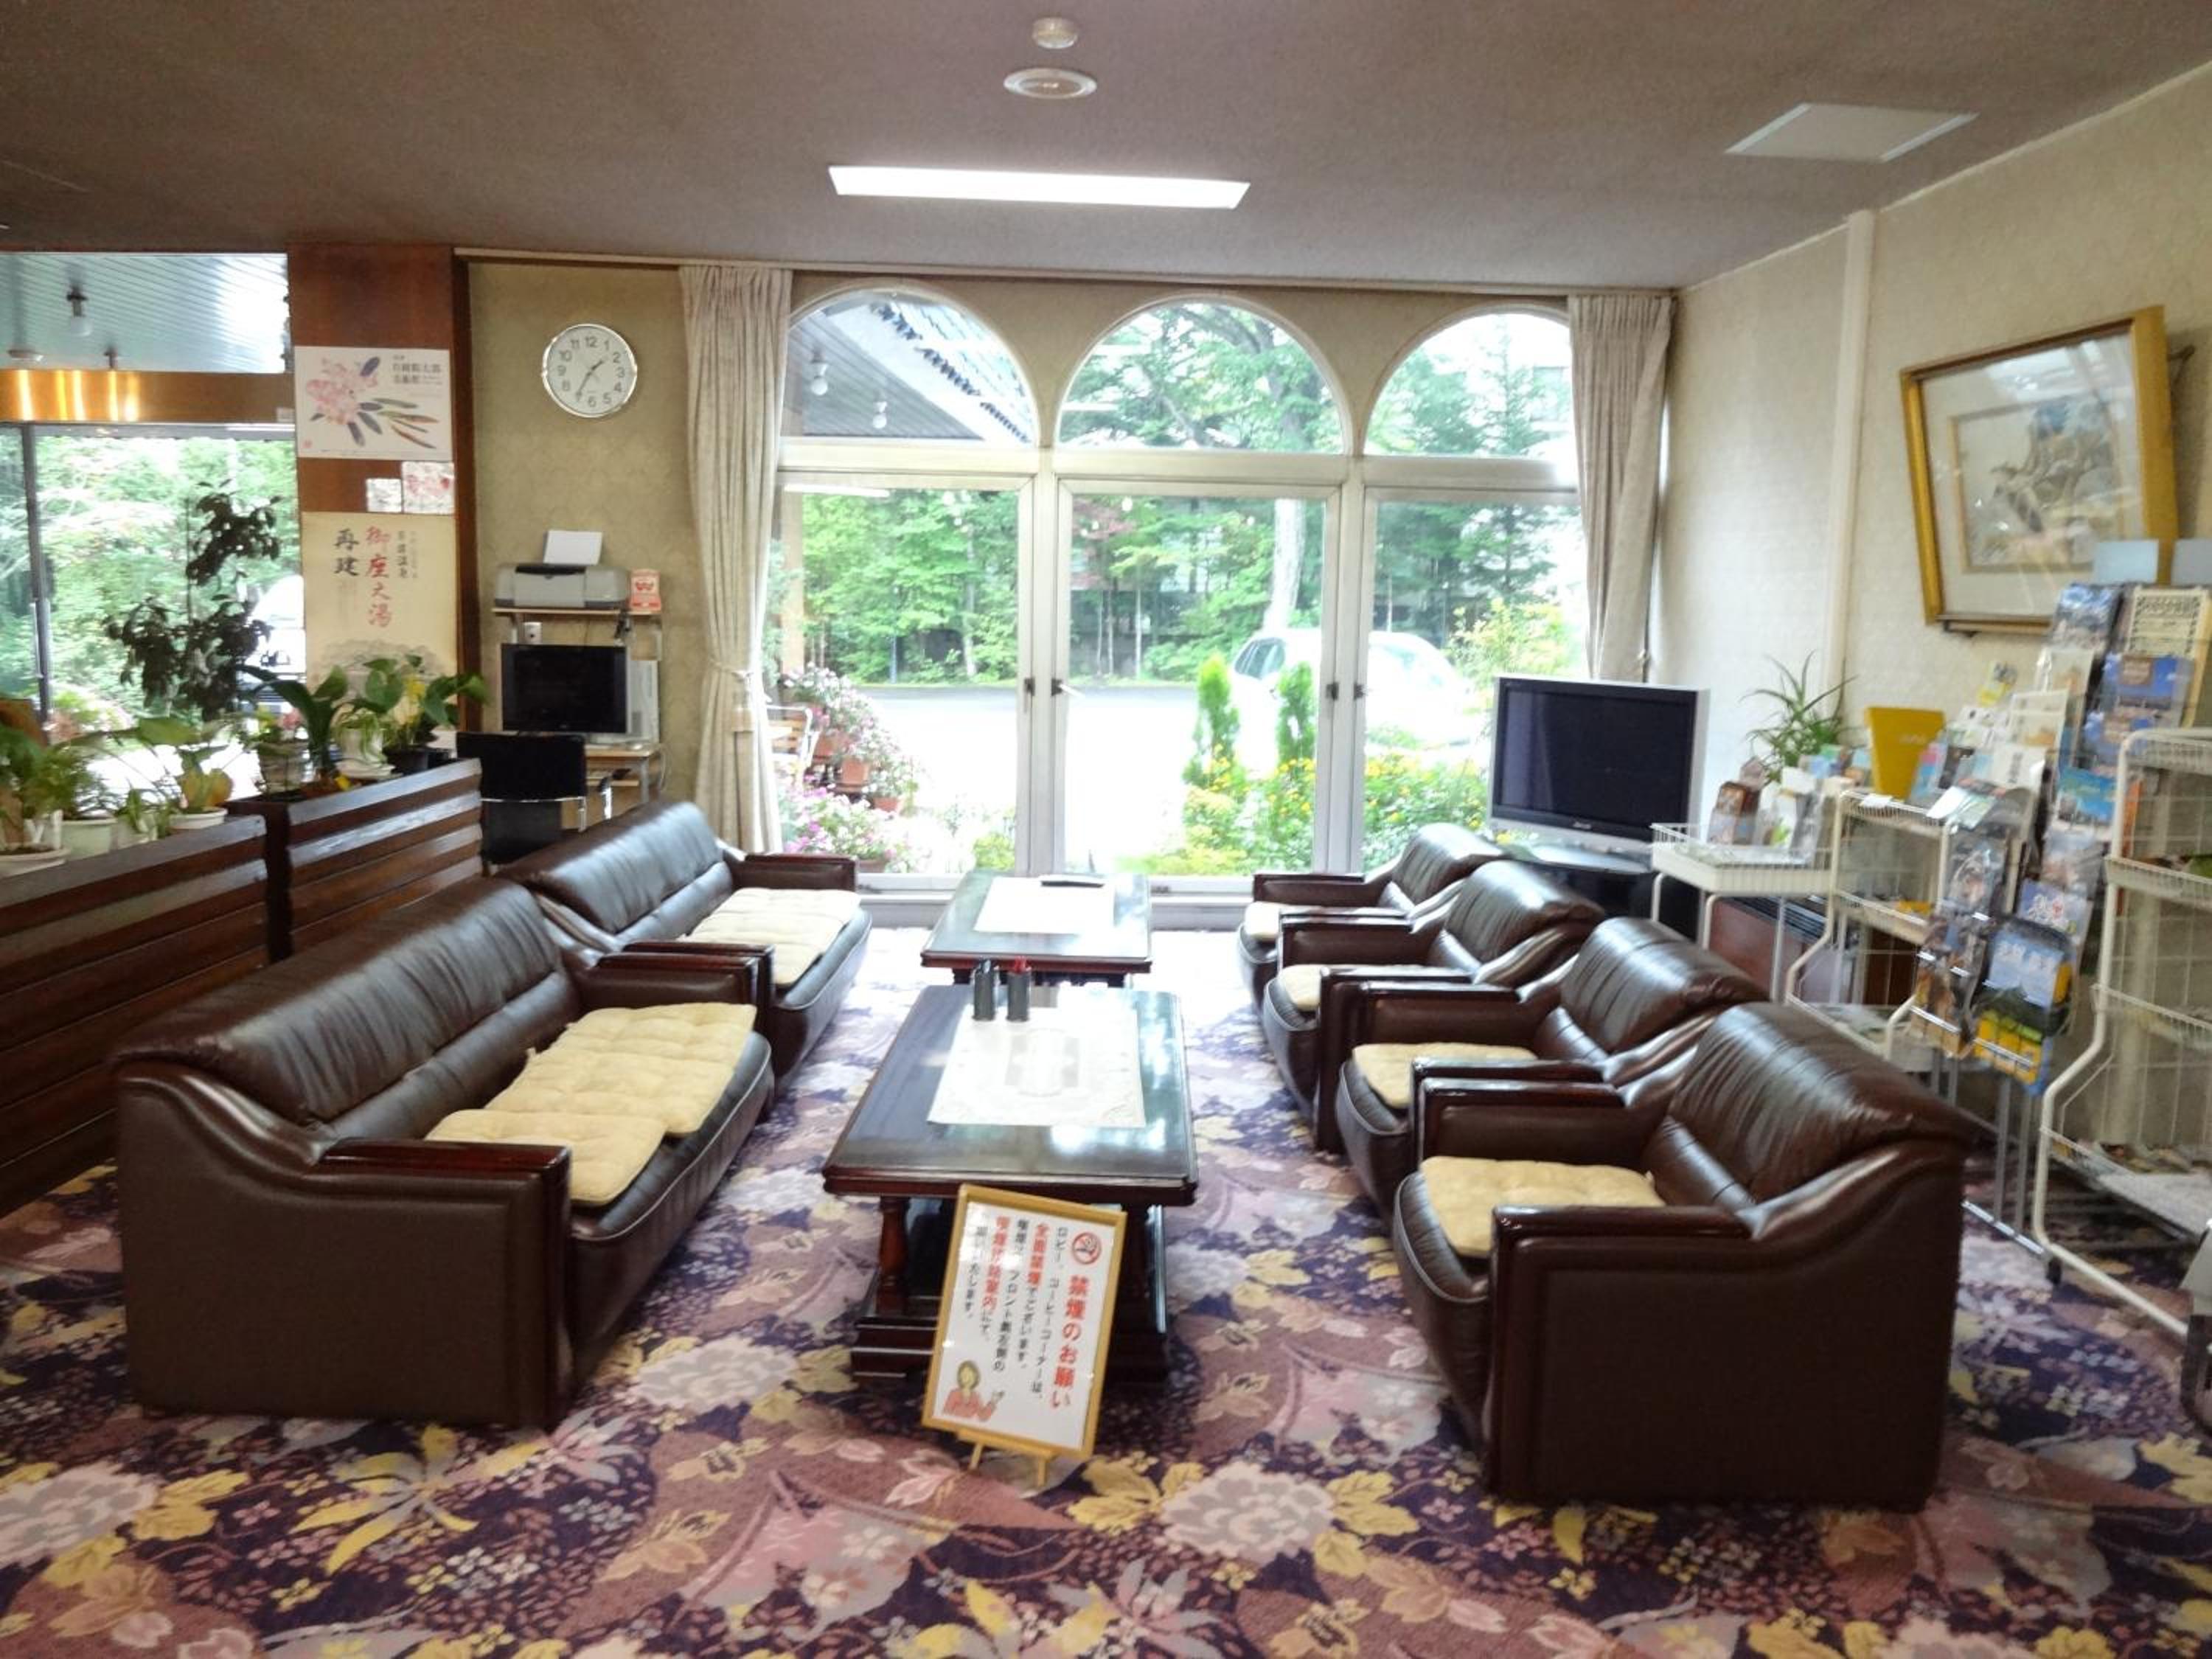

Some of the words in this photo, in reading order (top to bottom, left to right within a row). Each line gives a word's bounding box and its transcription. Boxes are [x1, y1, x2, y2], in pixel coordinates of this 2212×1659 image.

[571, 338, 580, 349] 11
[585, 335, 597, 348] 12
[604, 340, 610, 351] 1
[558, 349, 572, 361] 10
[613, 352, 621, 364] 2
[557, 365, 566, 376] 9
[616, 367, 625, 378] 3
[613, 382, 622, 392] 4
[588, 396, 597, 407] 6
[603, 392, 612, 404] 5
[333, 528, 360, 577] 再建
[1050, 1275, 1091, 1408] 禁煙のお願い
